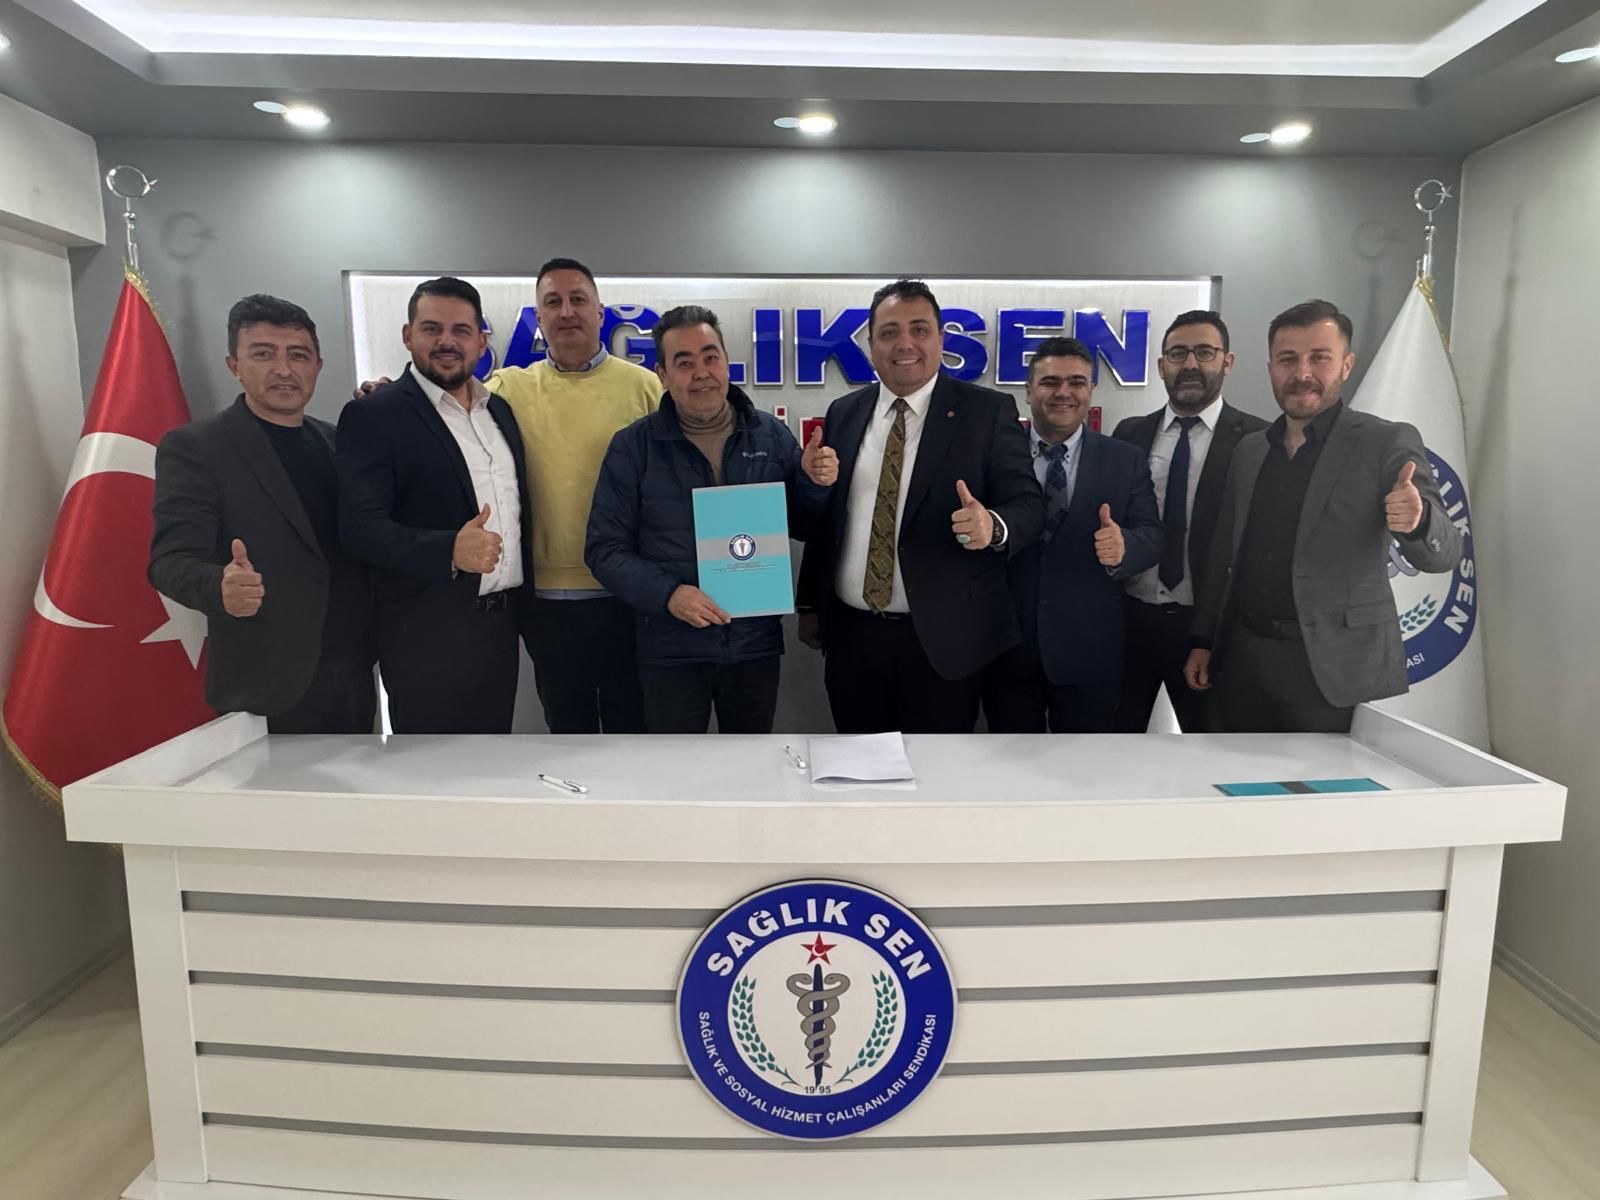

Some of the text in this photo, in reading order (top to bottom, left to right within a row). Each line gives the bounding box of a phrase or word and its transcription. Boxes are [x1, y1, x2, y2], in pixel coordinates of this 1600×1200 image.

[479, 304, 1151, 386] AĞIK SEN
[1444, 557, 1474, 635] SEN
[707, 898, 932, 980] SAĞLIK SEN
[699, 1011, 937, 1125] SAĞLIK VE SOSYAL HİZMET ÇALIŞANLARI SENDİKASI
